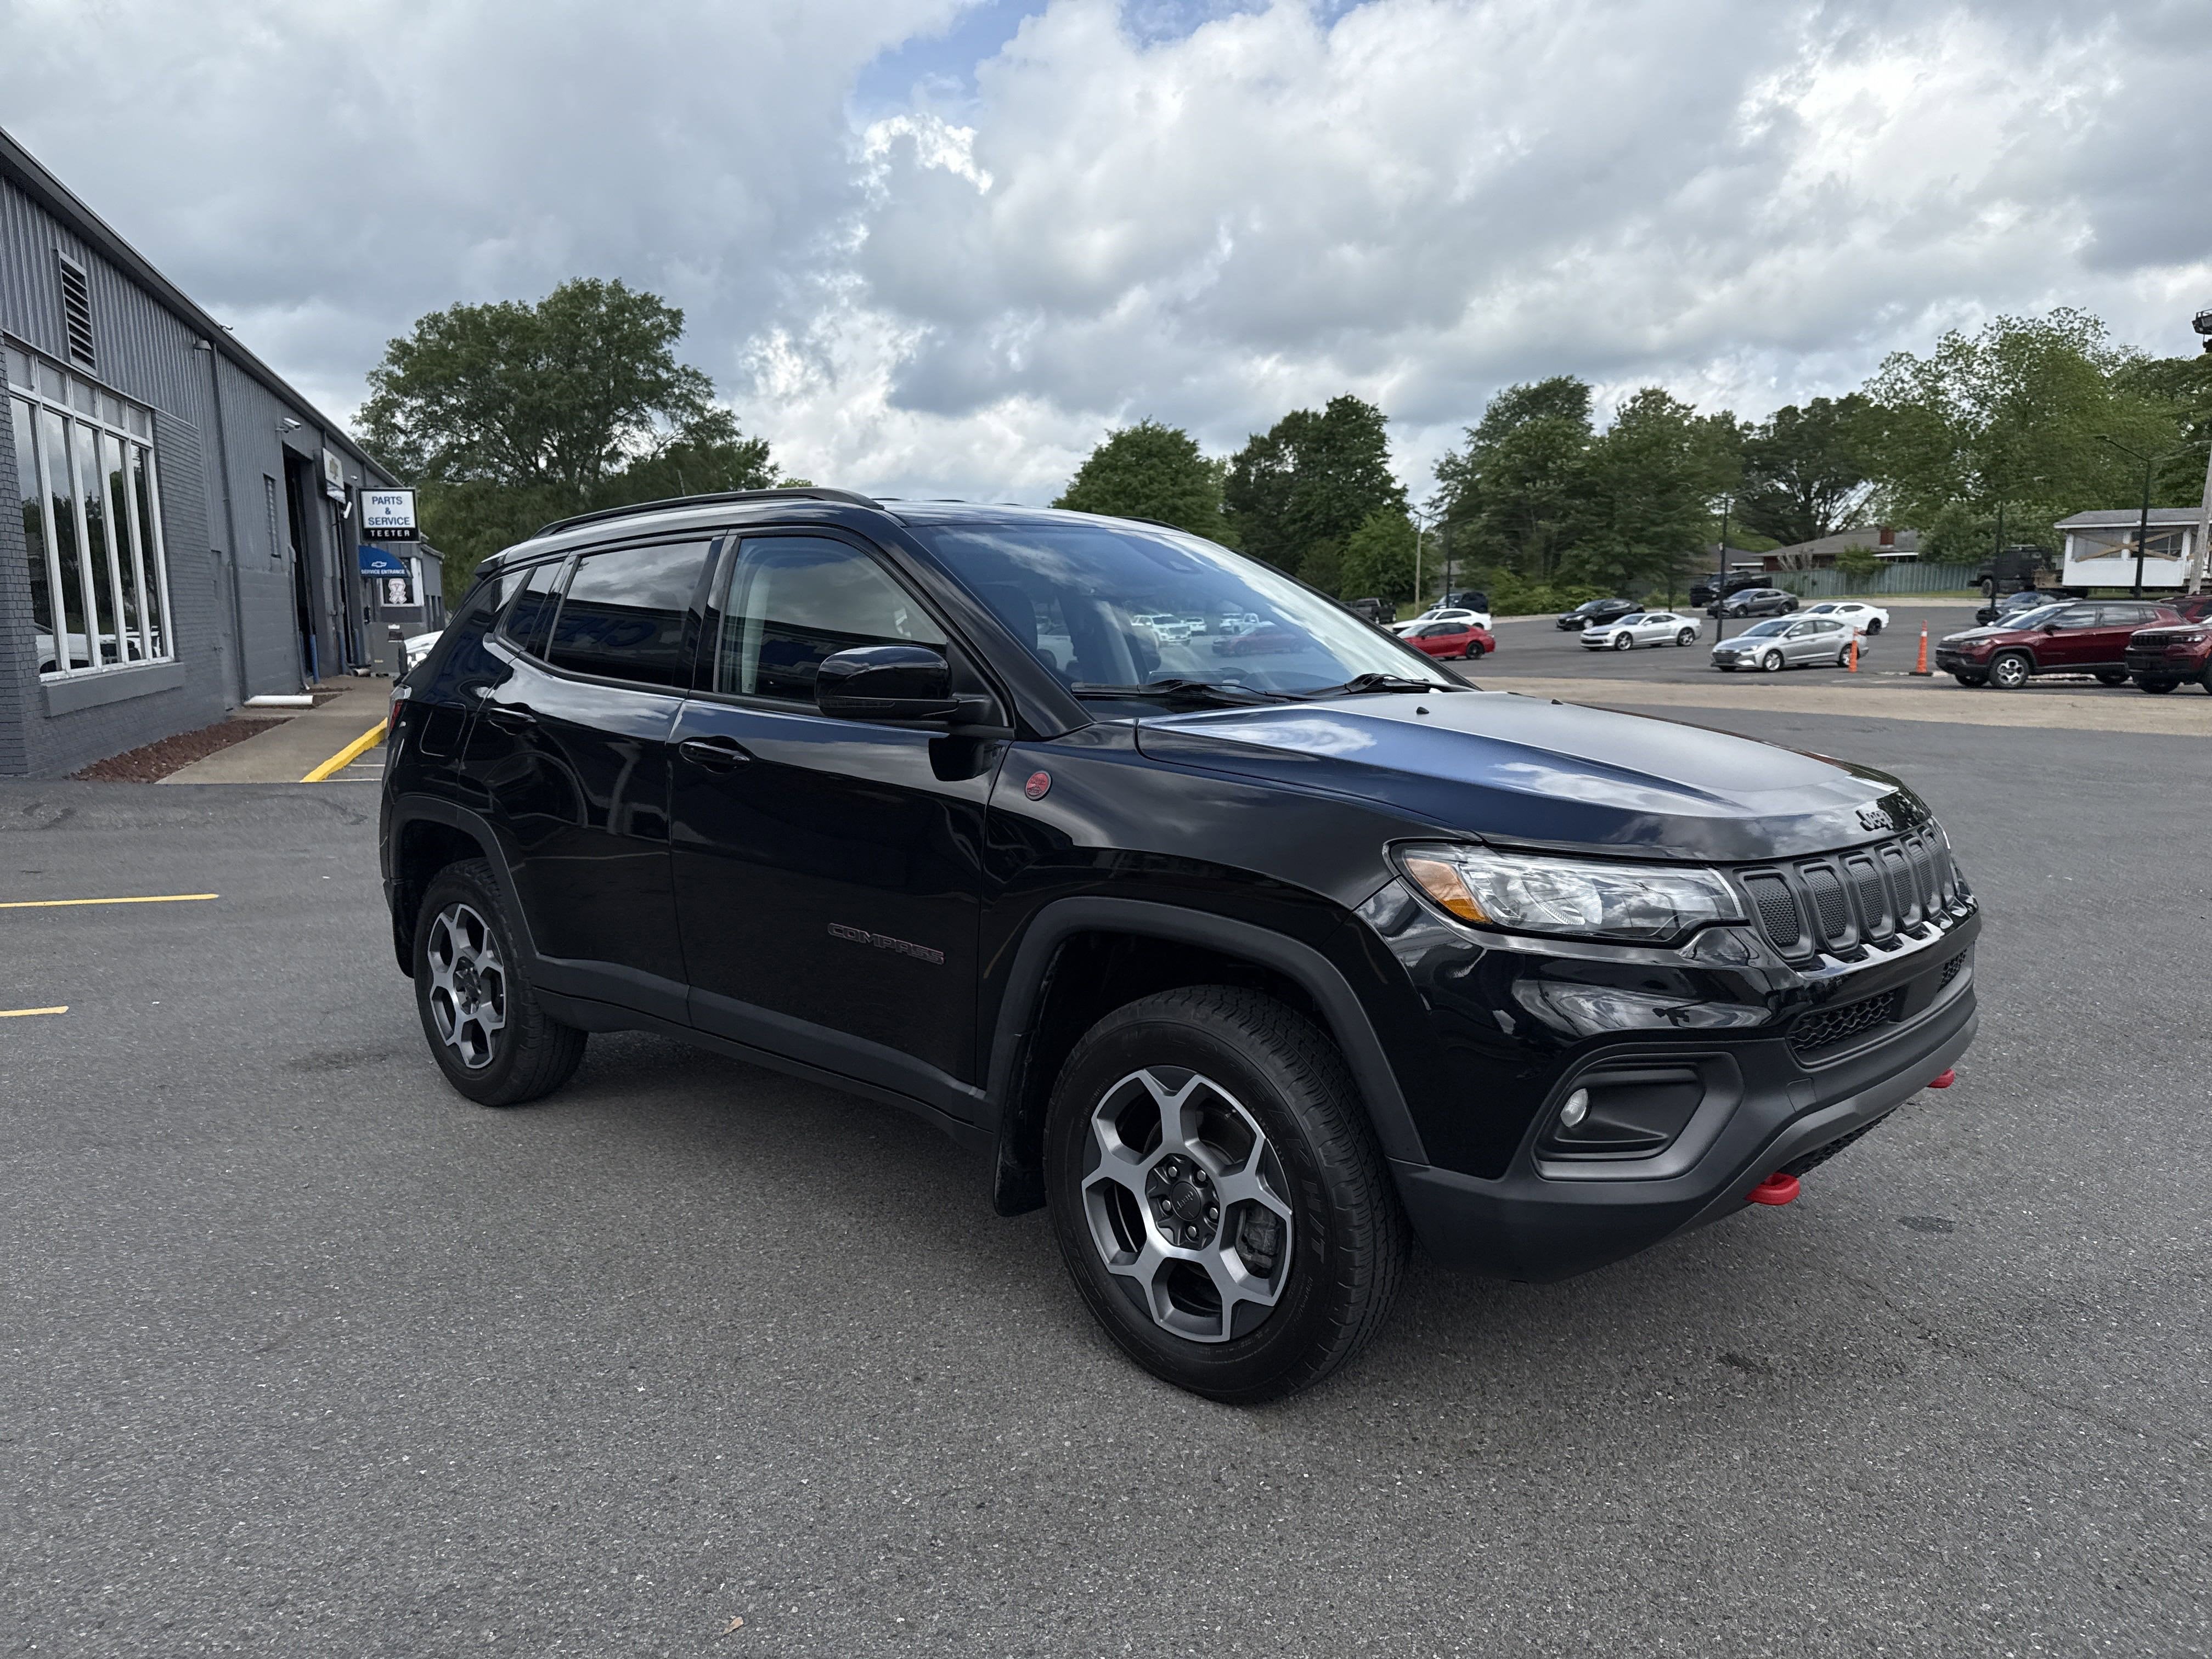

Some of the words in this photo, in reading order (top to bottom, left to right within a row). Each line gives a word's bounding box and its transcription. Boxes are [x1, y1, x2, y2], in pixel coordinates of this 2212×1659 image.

[371, 496, 403, 505] PARTS
[368, 517, 410, 526] SERVICE
[1855, 810, 1893, 832] Jeep
[827, 923, 944, 965] COMPASS
